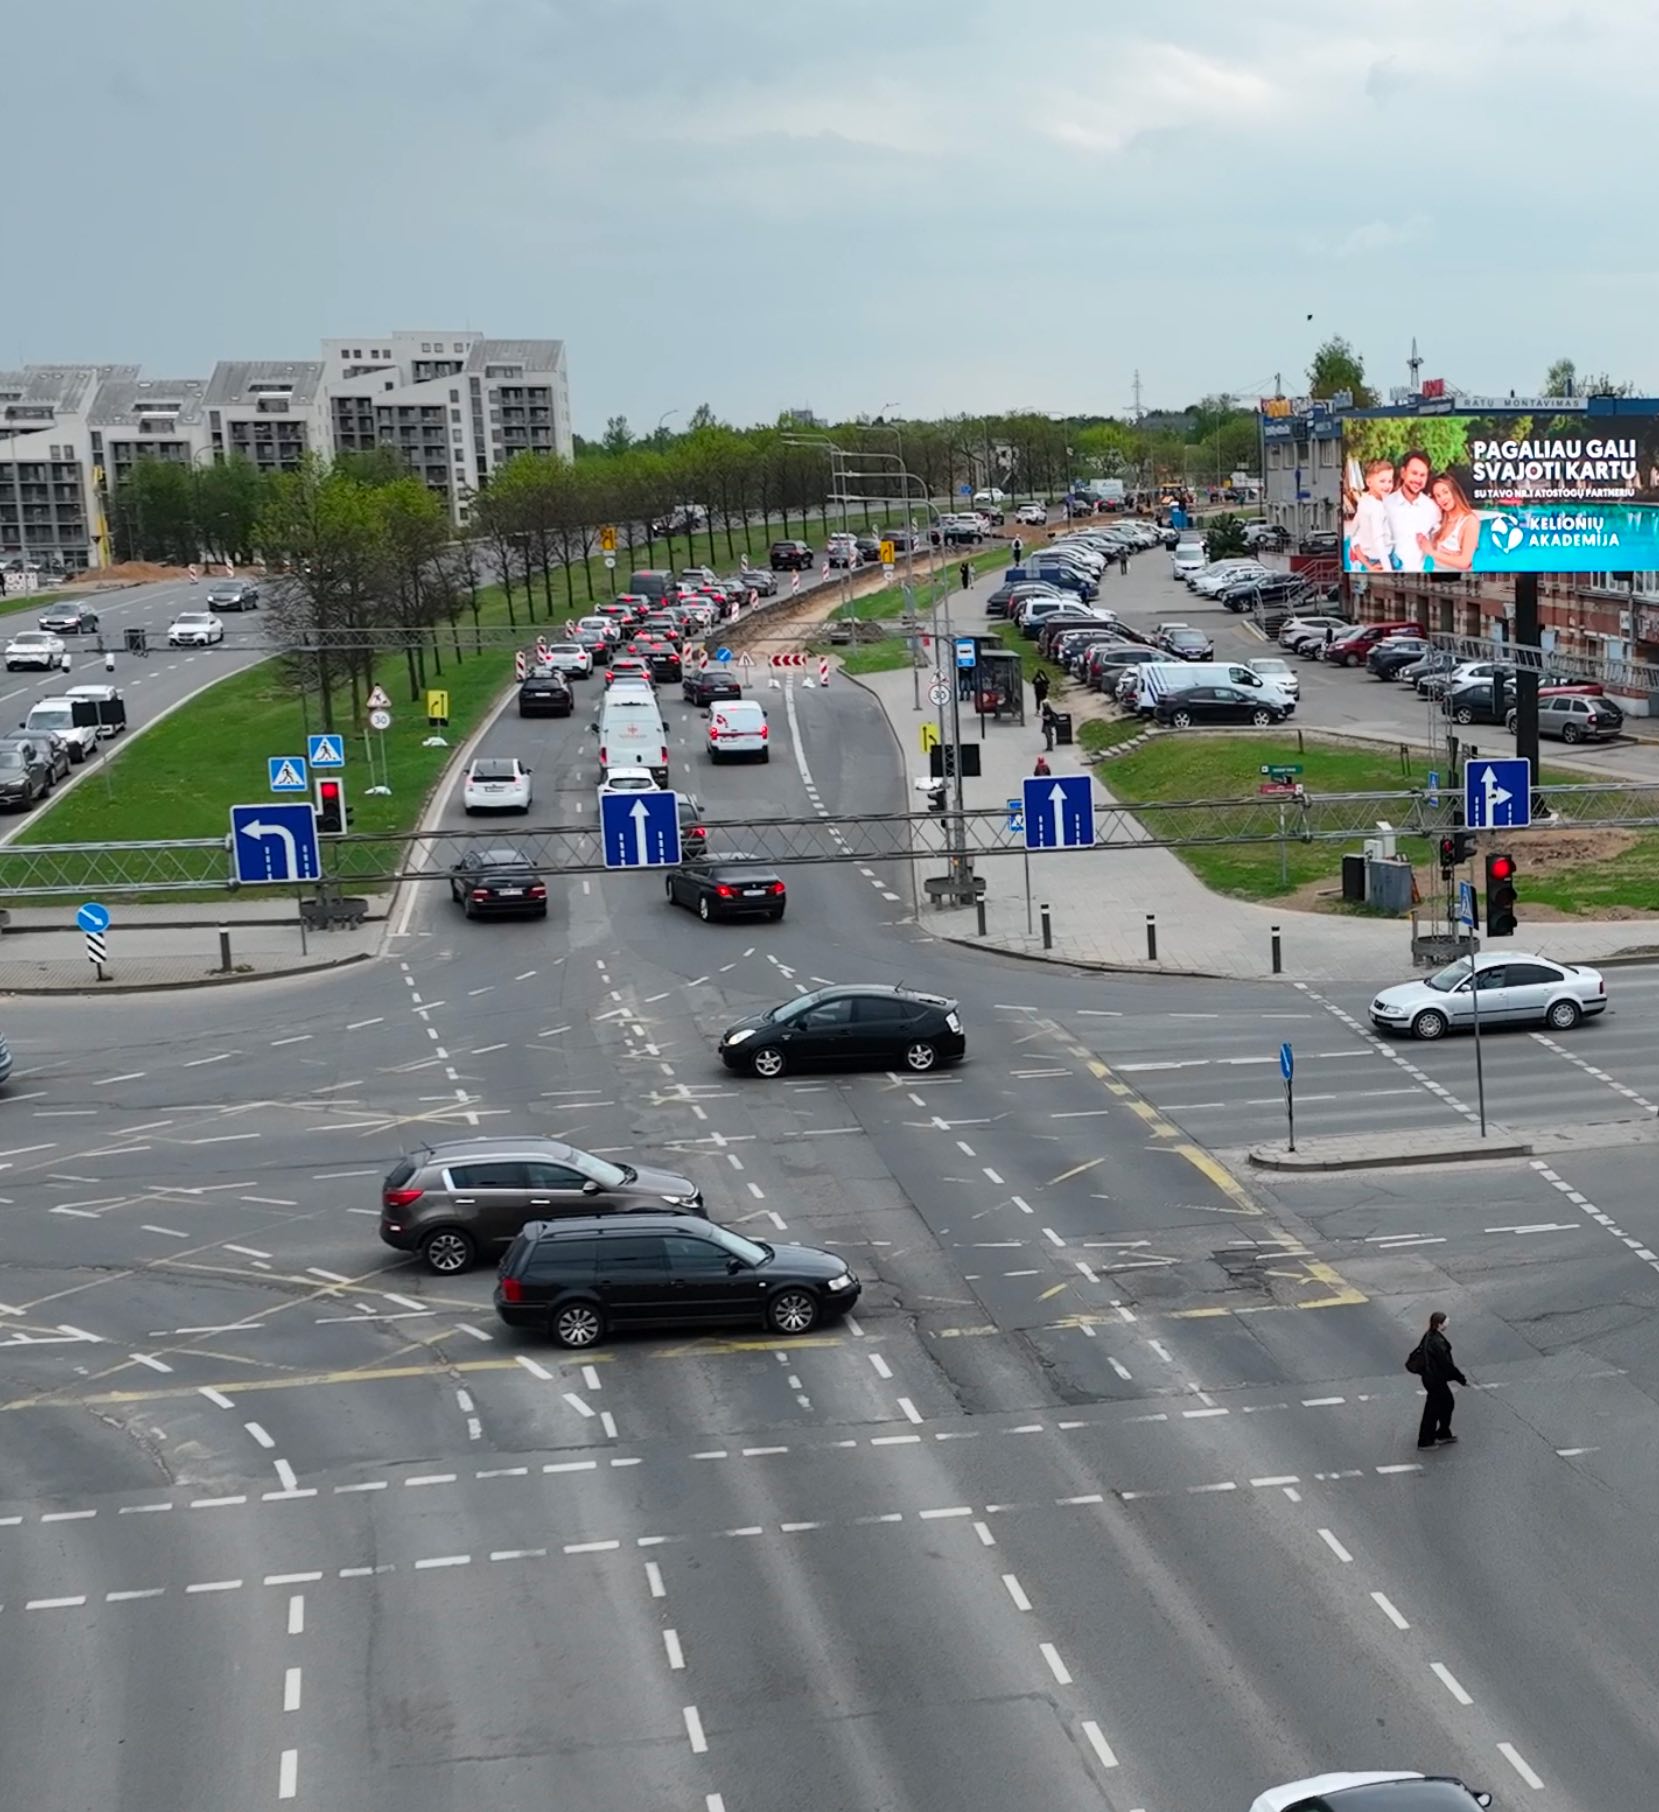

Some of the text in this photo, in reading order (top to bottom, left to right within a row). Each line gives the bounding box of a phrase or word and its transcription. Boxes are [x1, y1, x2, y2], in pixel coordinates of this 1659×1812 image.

[1504, 399, 1579, 408] MONTAVIMAS
[1473, 439, 1636, 459] PAGALIAU GALI
[1473, 461, 1636, 481] SVAJOTI KARTU
[1474, 490, 1486, 498] SU
[1487, 489, 1513, 498] TAVO
[1585, 488, 1635, 498] PARTNERIU
[1530, 517, 1604, 533] KELIONIŲ
[1529, 533, 1620, 547] AKADEMIJA
[934, 690, 947, 699] 30
[374, 715, 388, 725] 30
